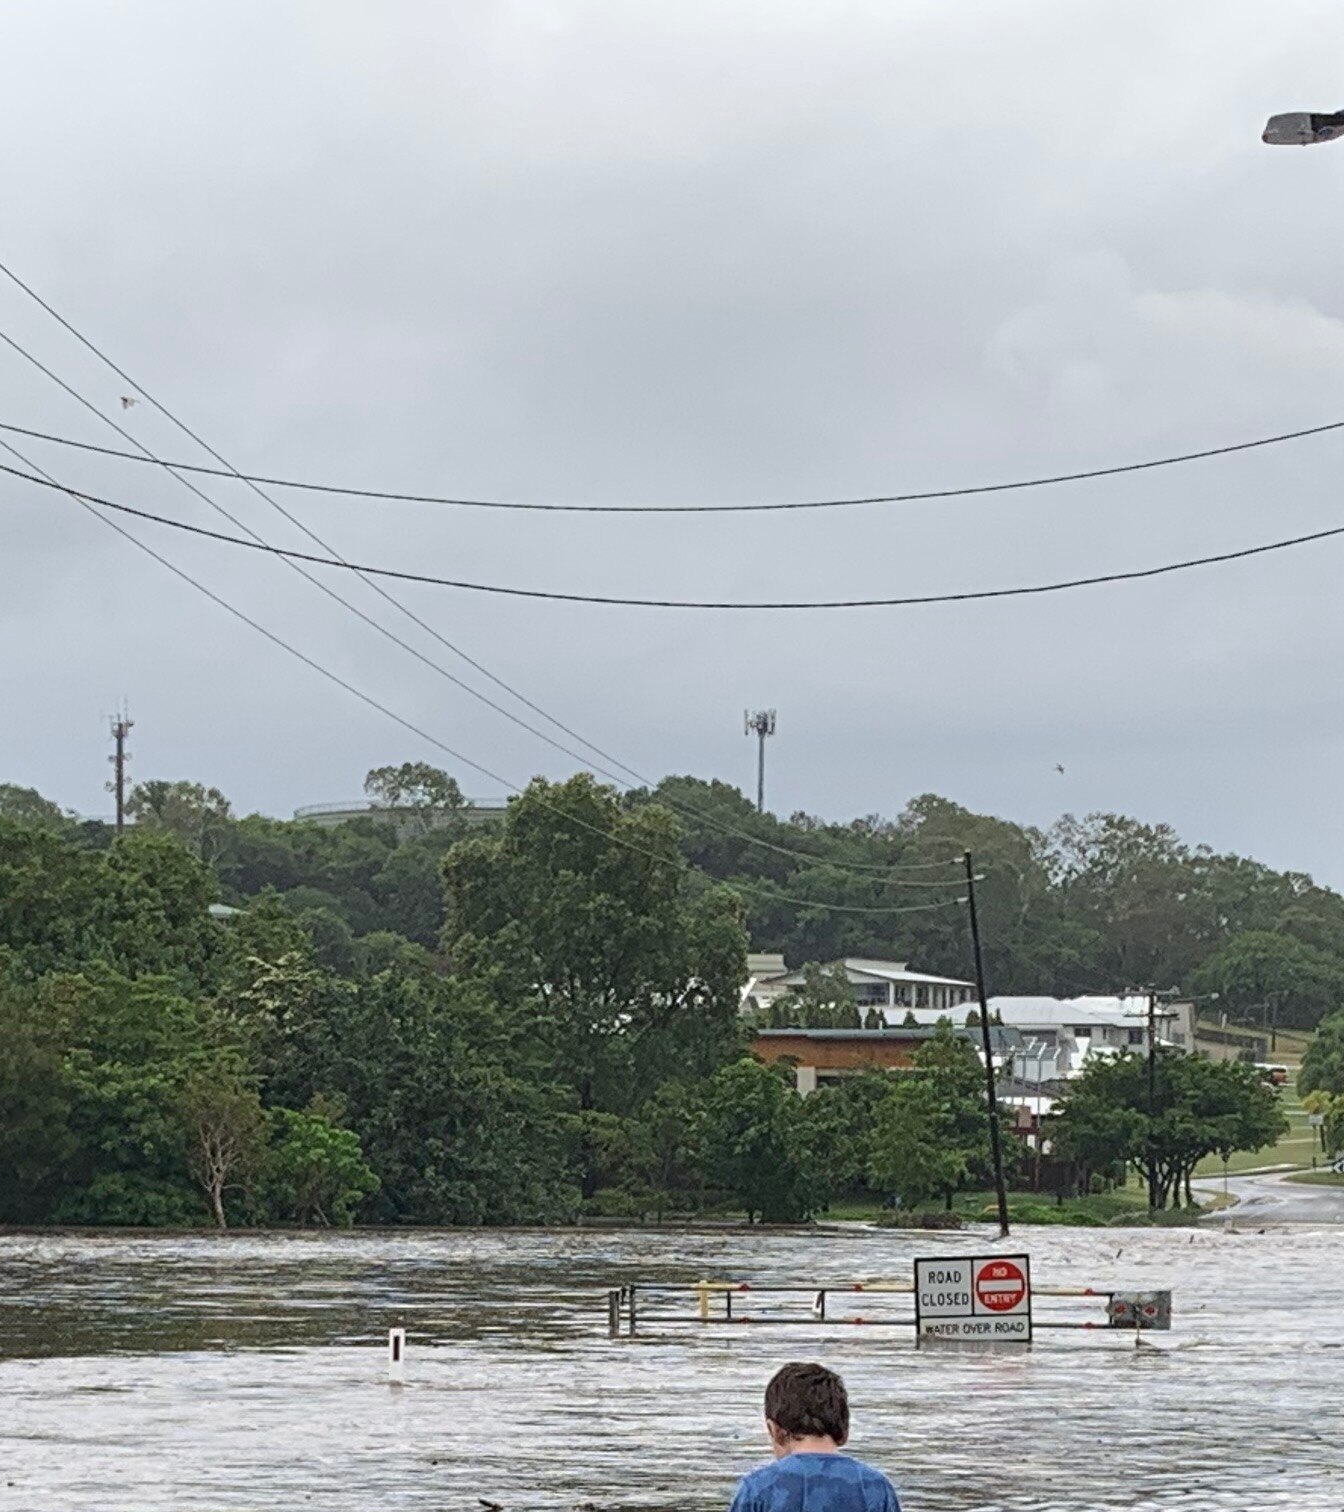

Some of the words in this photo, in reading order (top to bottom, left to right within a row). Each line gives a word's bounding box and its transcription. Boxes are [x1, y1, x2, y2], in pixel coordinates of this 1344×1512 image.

[928, 1270, 962, 1284] ROAD
[991, 1267, 1008, 1277] NO
[921, 1292, 969, 1307] CLOSED
[984, 1293, 1017, 1304] ENTRY
[925, 1323, 959, 1335] WATER
[962, 1322, 992, 1334] OVER
[994, 1321, 1025, 1333] ROAD
